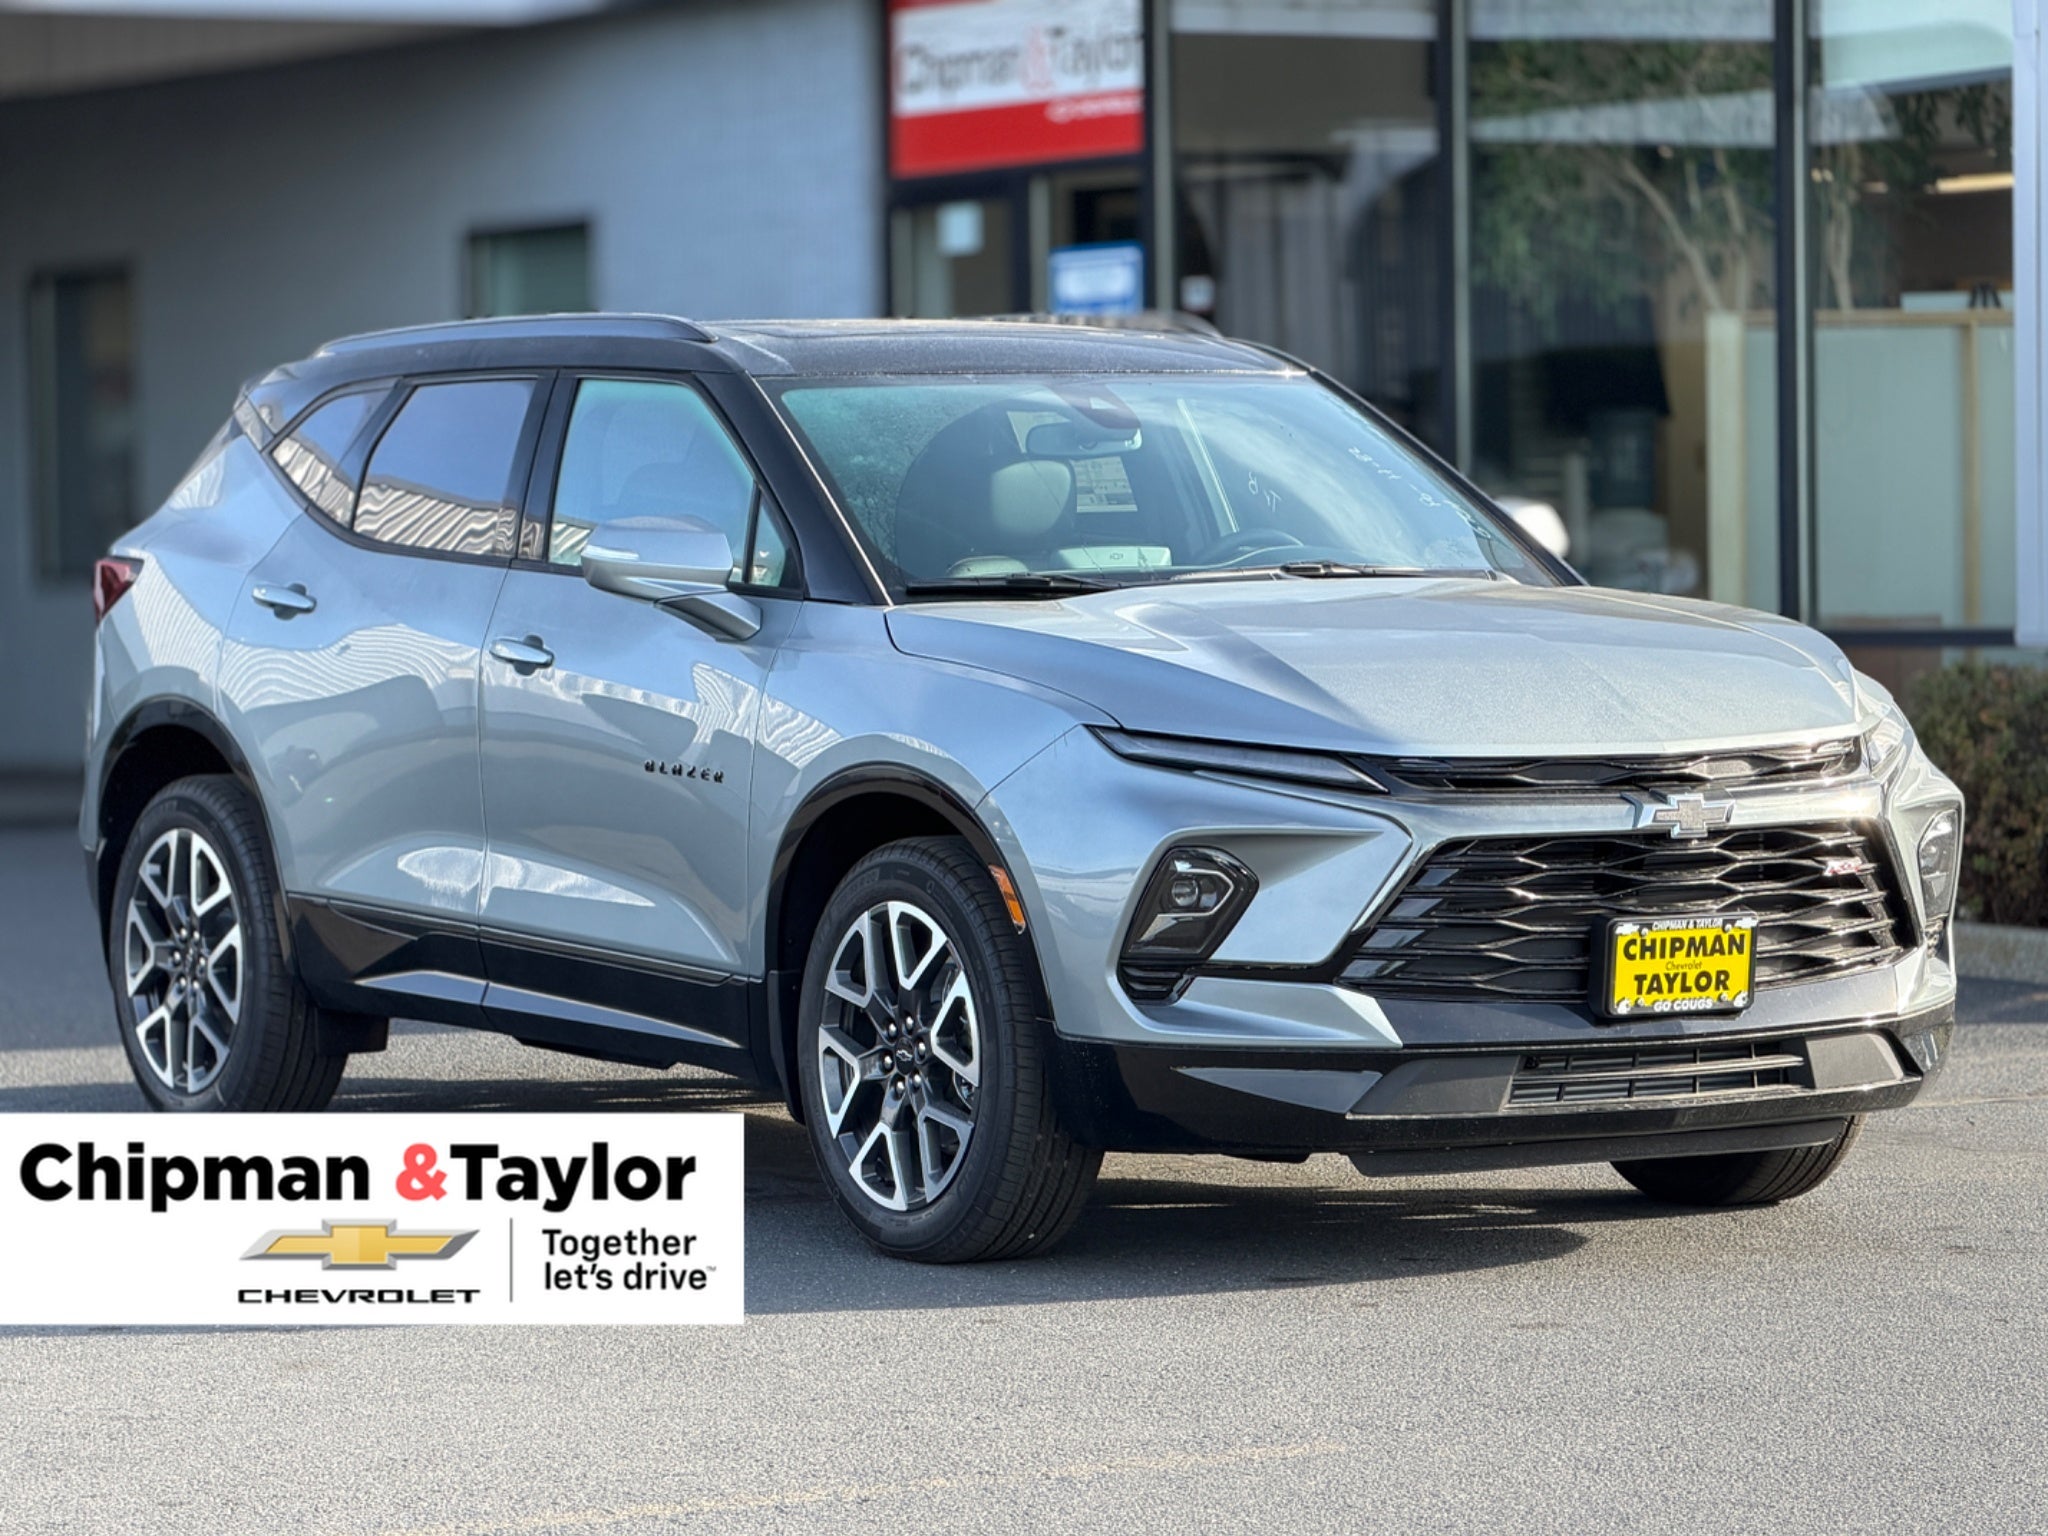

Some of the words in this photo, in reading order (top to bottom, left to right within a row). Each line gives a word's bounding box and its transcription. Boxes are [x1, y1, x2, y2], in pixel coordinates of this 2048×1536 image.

[644, 760, 724, 783] BLAZER
[1652, 919, 1687, 932] CHIPMAN
[1696, 917, 1723, 930] TAYLOR
[1623, 934, 1745, 961] CHIPMAN
[1665, 960, 1702, 971] Chevrolet
[1634, 970, 1730, 995] TAYLOR
[1653, 1000, 1672, 1012] GO
[1673, 997, 1713, 1011] COUGS
